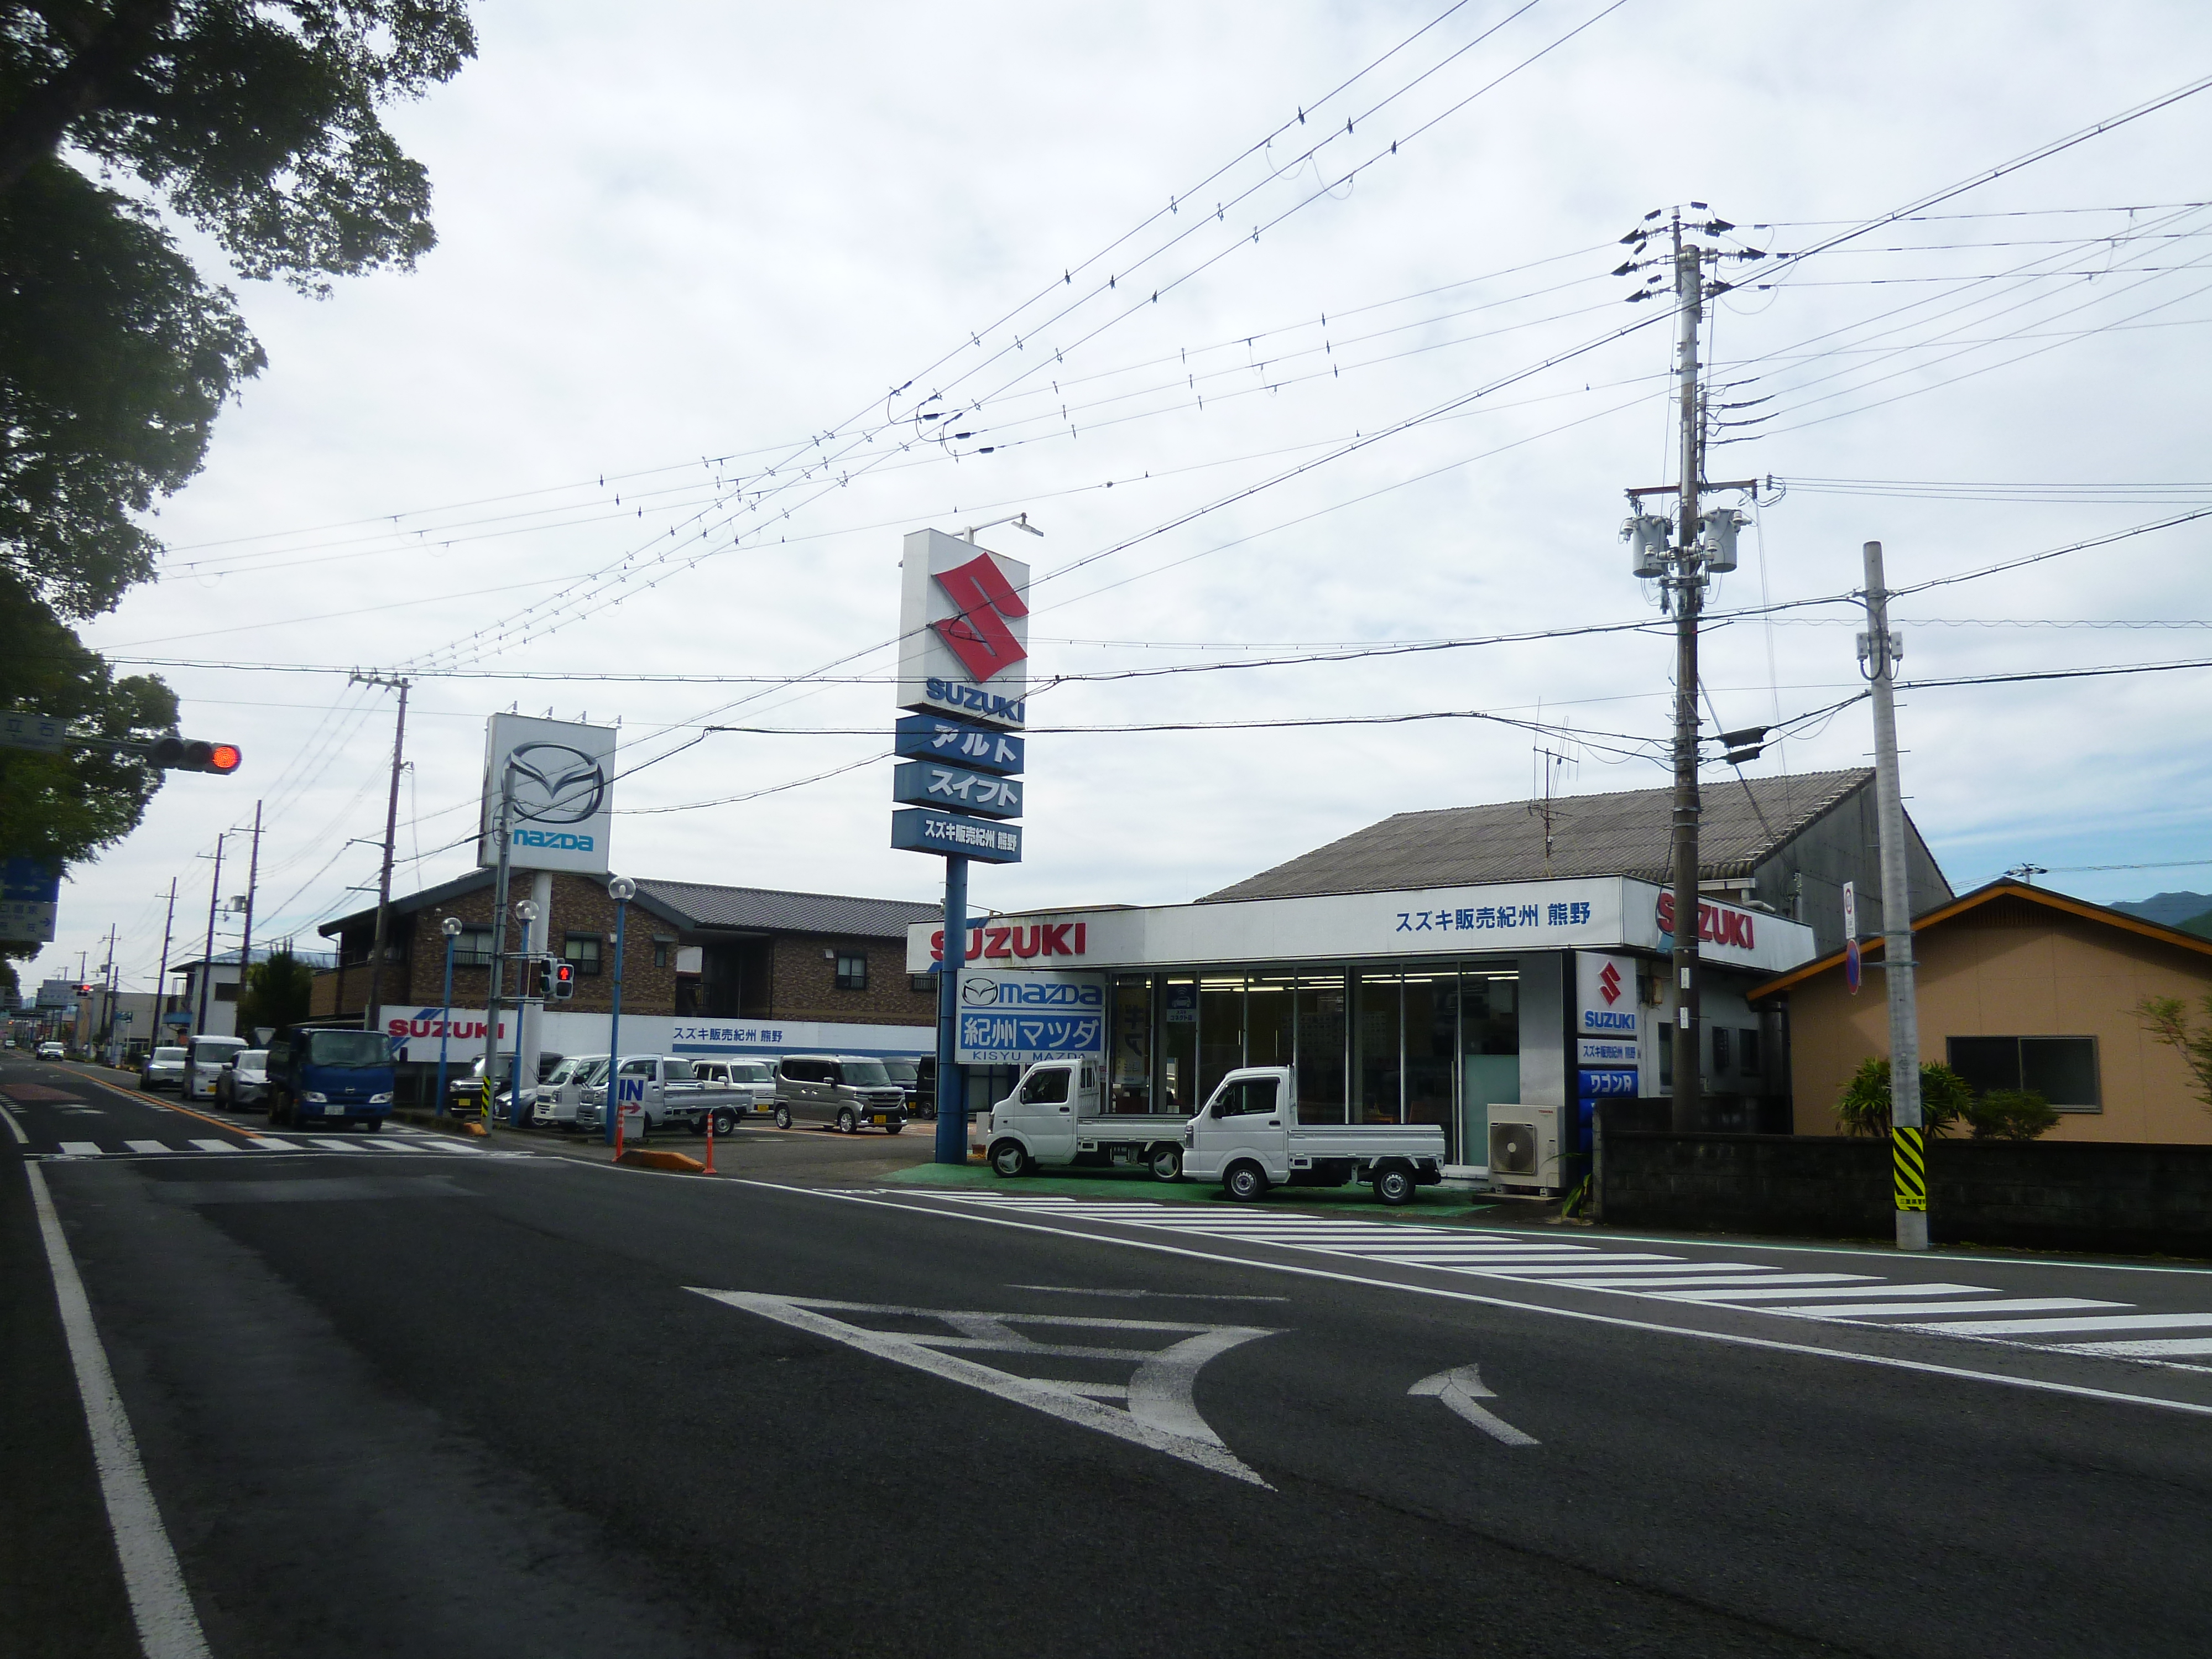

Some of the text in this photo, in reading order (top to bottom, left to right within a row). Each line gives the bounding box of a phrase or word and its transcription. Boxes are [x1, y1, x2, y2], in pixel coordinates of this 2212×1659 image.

[926, 677, 1025, 722] SUZUKI
[931, 724, 1016, 763] アルト
[927, 769, 1018, 806] スイフト
[925, 820, 1017, 852] スズキ販売紀州 熊野
[1395, 901, 1590, 932] スズキ販売紀州 熊野
[1658, 893, 1754, 949] SZUKI
[999, 983, 1102, 1005] mazda
[388, 1019, 504, 1039] SUZUKI
[964, 1017, 1099, 1047] 紀州マツダ
[1585, 1010, 1635, 1030] SUZUKI
[673, 1027, 782, 1042] スズキ販売紀州 熊野
[973, 1051, 1086, 1061] KISYU MAZDA
[619, 1079, 644, 1100] IN
[1590, 1074, 1631, 1093] ワゴンR
